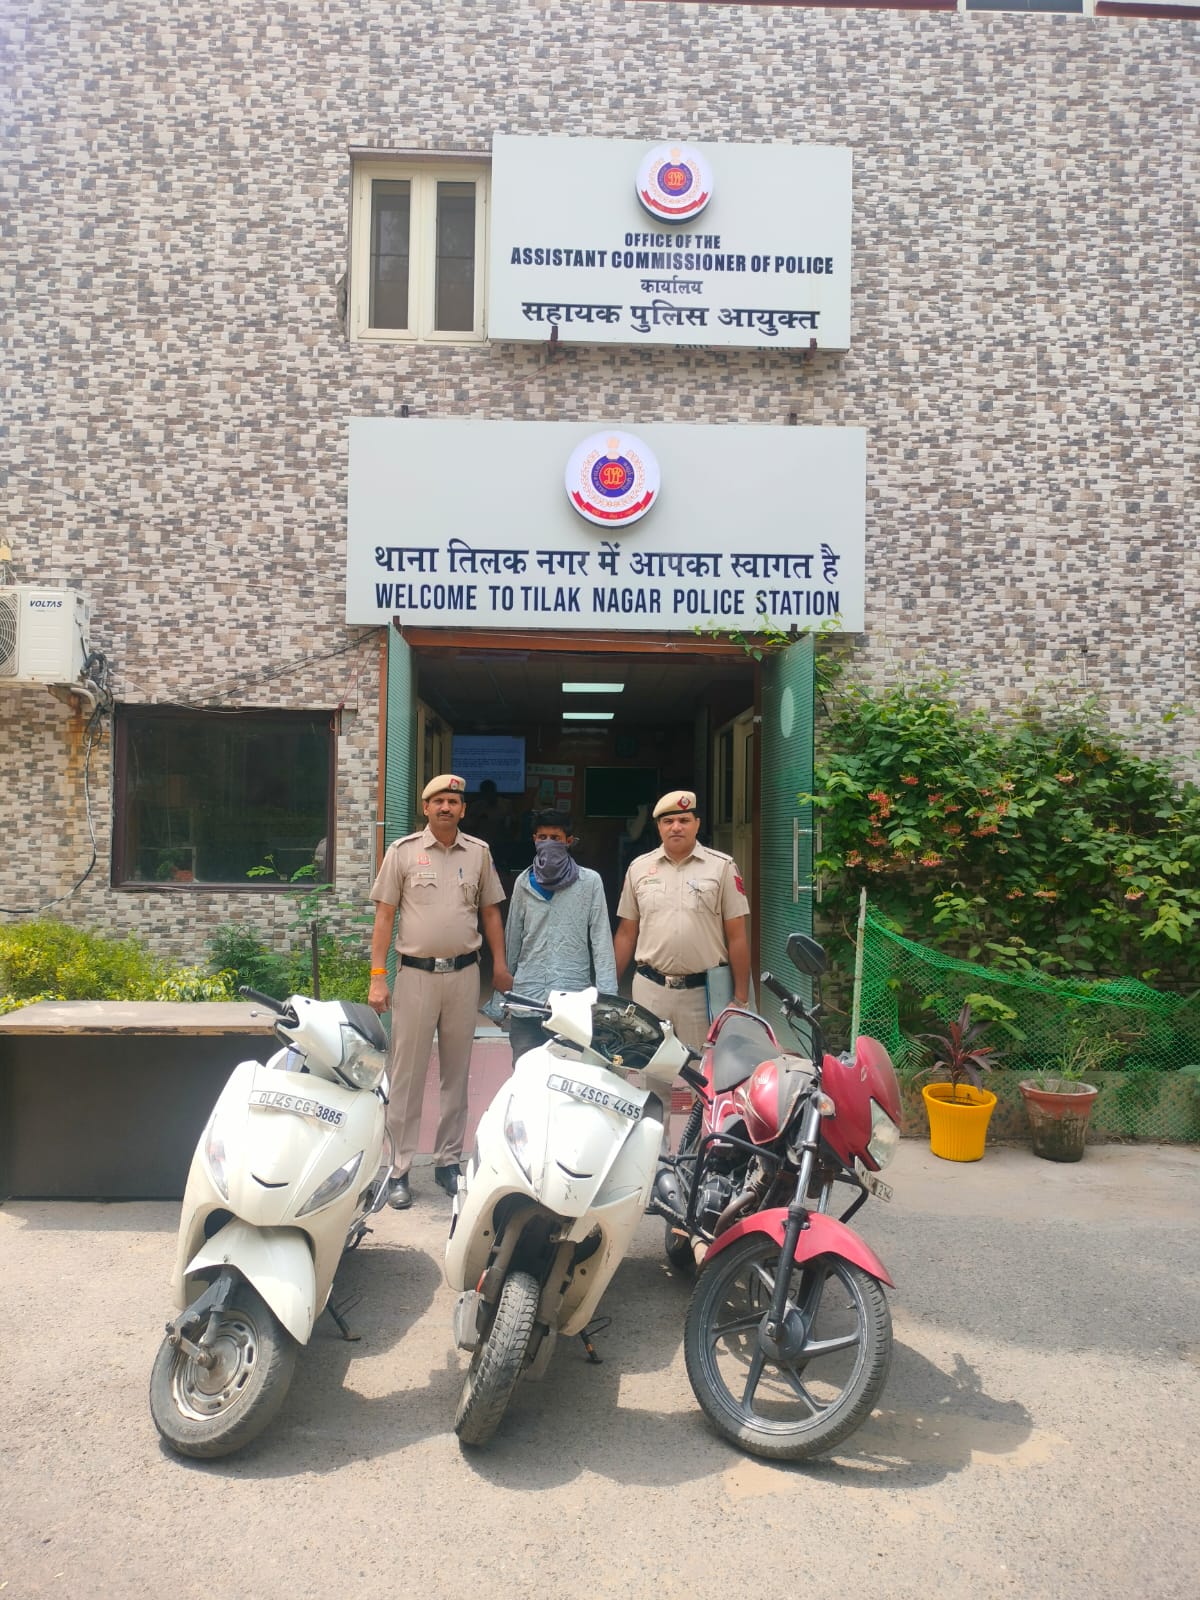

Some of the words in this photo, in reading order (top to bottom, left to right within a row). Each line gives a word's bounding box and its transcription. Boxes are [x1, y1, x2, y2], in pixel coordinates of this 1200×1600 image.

[624, 232, 673, 248] OFFICE
[675, 234, 692, 248] OF
[694, 234, 721, 249] THE
[510, 246, 608, 268] ASSISTANT
[611, 250, 747, 272] COMMISSIONER
[750, 254, 771, 273] OF
[774, 255, 834, 275] POLICE
[640, 275, 704, 295] कार्यालय
[521, 301, 624, 326] सहायक
[629, 299, 710, 334] पुलिस
[717, 307, 821, 337] आयुक्त
[374, 546, 440, 573] थाना
[446, 537, 530, 575] तिलक
[535, 550, 590, 577] नगर
[597, 541, 621, 576] में
[629, 551, 724, 578] आपका
[730, 553, 814, 580] स्वागत
[820, 543, 841, 585] है
[29, 600, 63, 608] VOLTAS
[375, 583, 478, 611] WELCOME
[488, 585, 514, 612] TO
[519, 586, 581, 613] TILAK
[592, 587, 661, 614] NAGAR
[673, 588, 745, 615] POLICE
[755, 589, 841, 616] STATION
[560, 1079, 574, 1094] DL
[613, 1099, 641, 1119] 4455
[315, 1106, 342, 1125] 3885
